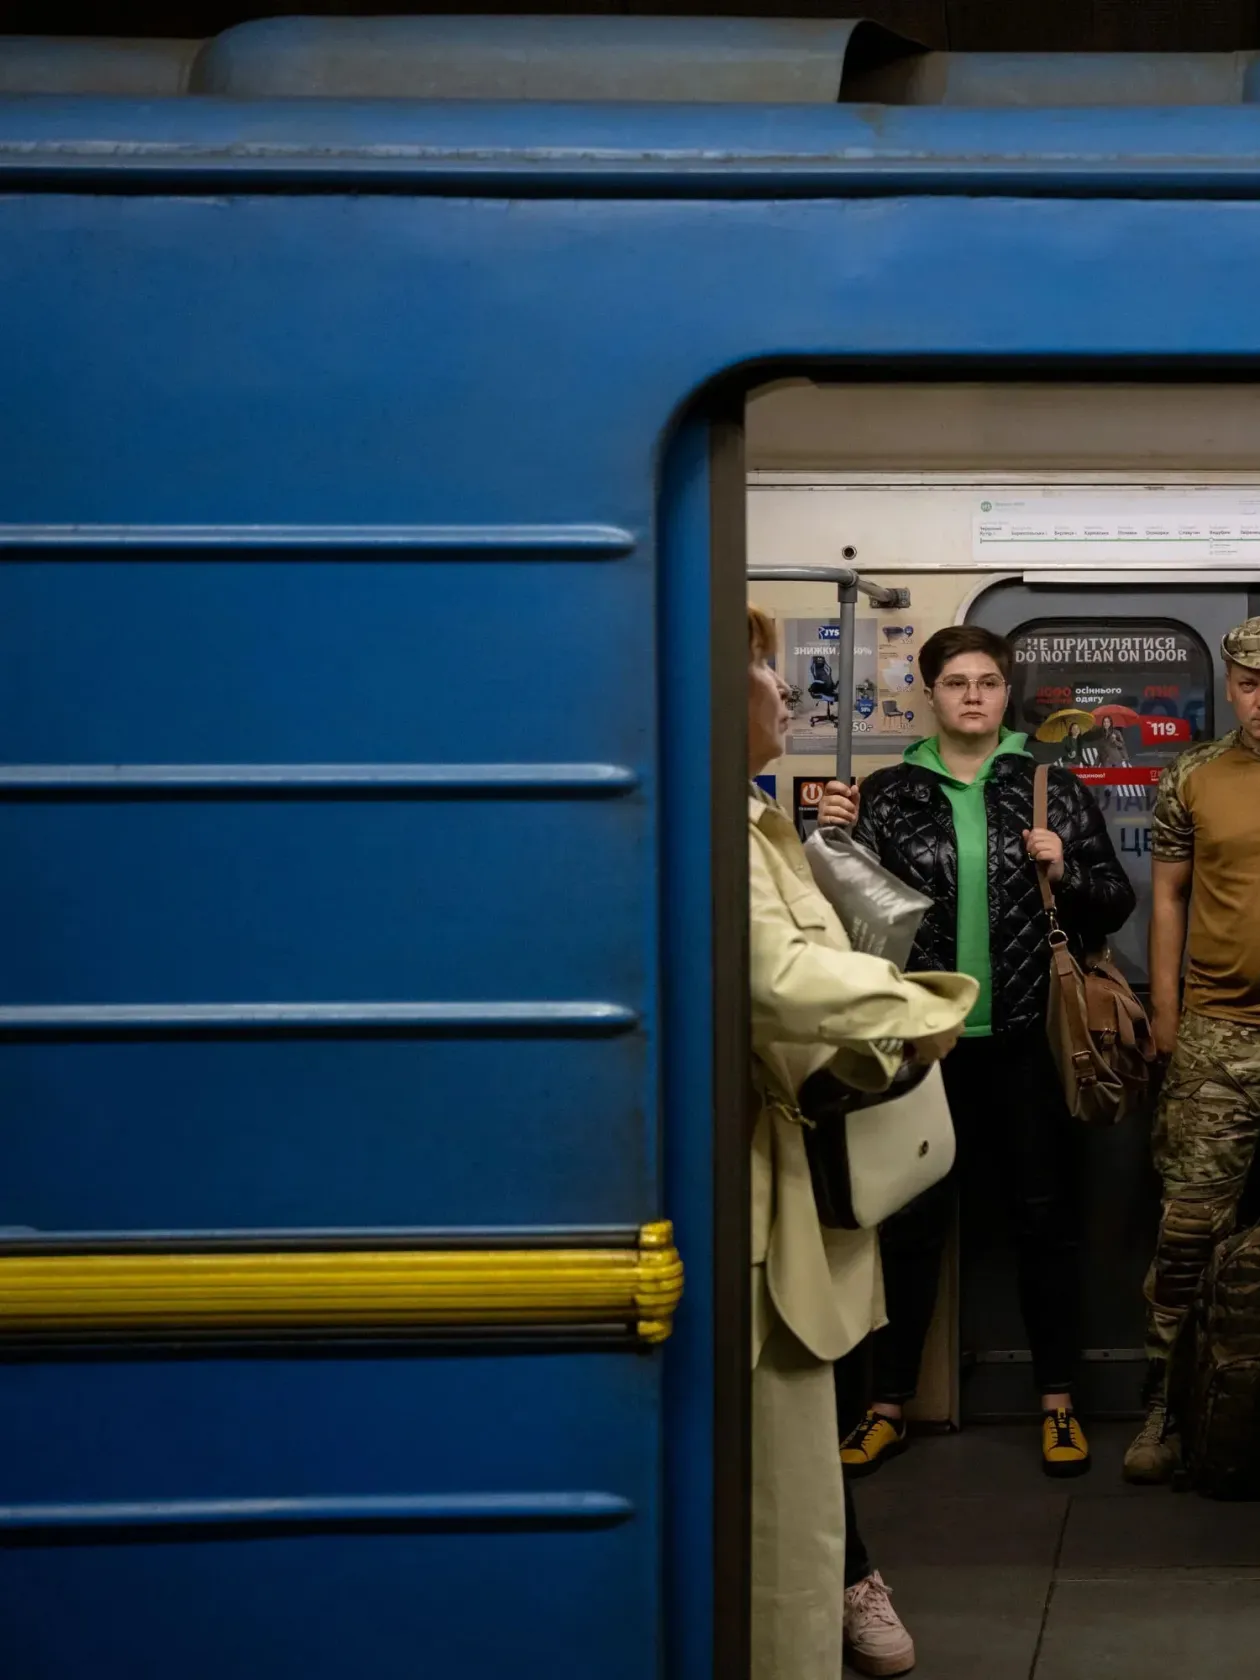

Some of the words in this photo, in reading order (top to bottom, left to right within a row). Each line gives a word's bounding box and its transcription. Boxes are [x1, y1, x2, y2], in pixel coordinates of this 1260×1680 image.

[823, 628, 841, 637] JYS
[1053, 637, 1176, 650] ПРИТУЛЯТИСЯ
[793, 646, 836, 656] ЗНИЖКИ
[1015, 651, 1037, 663] DO
[1040, 650, 1070, 663] NOT
[1075, 650, 1114, 663] LEAN
[1118, 650, 1140, 662] ON
[1144, 649, 1187, 662] DOOR
[1075, 686, 1122, 695] осіннього
[1075, 696, 1104, 704] одягу
